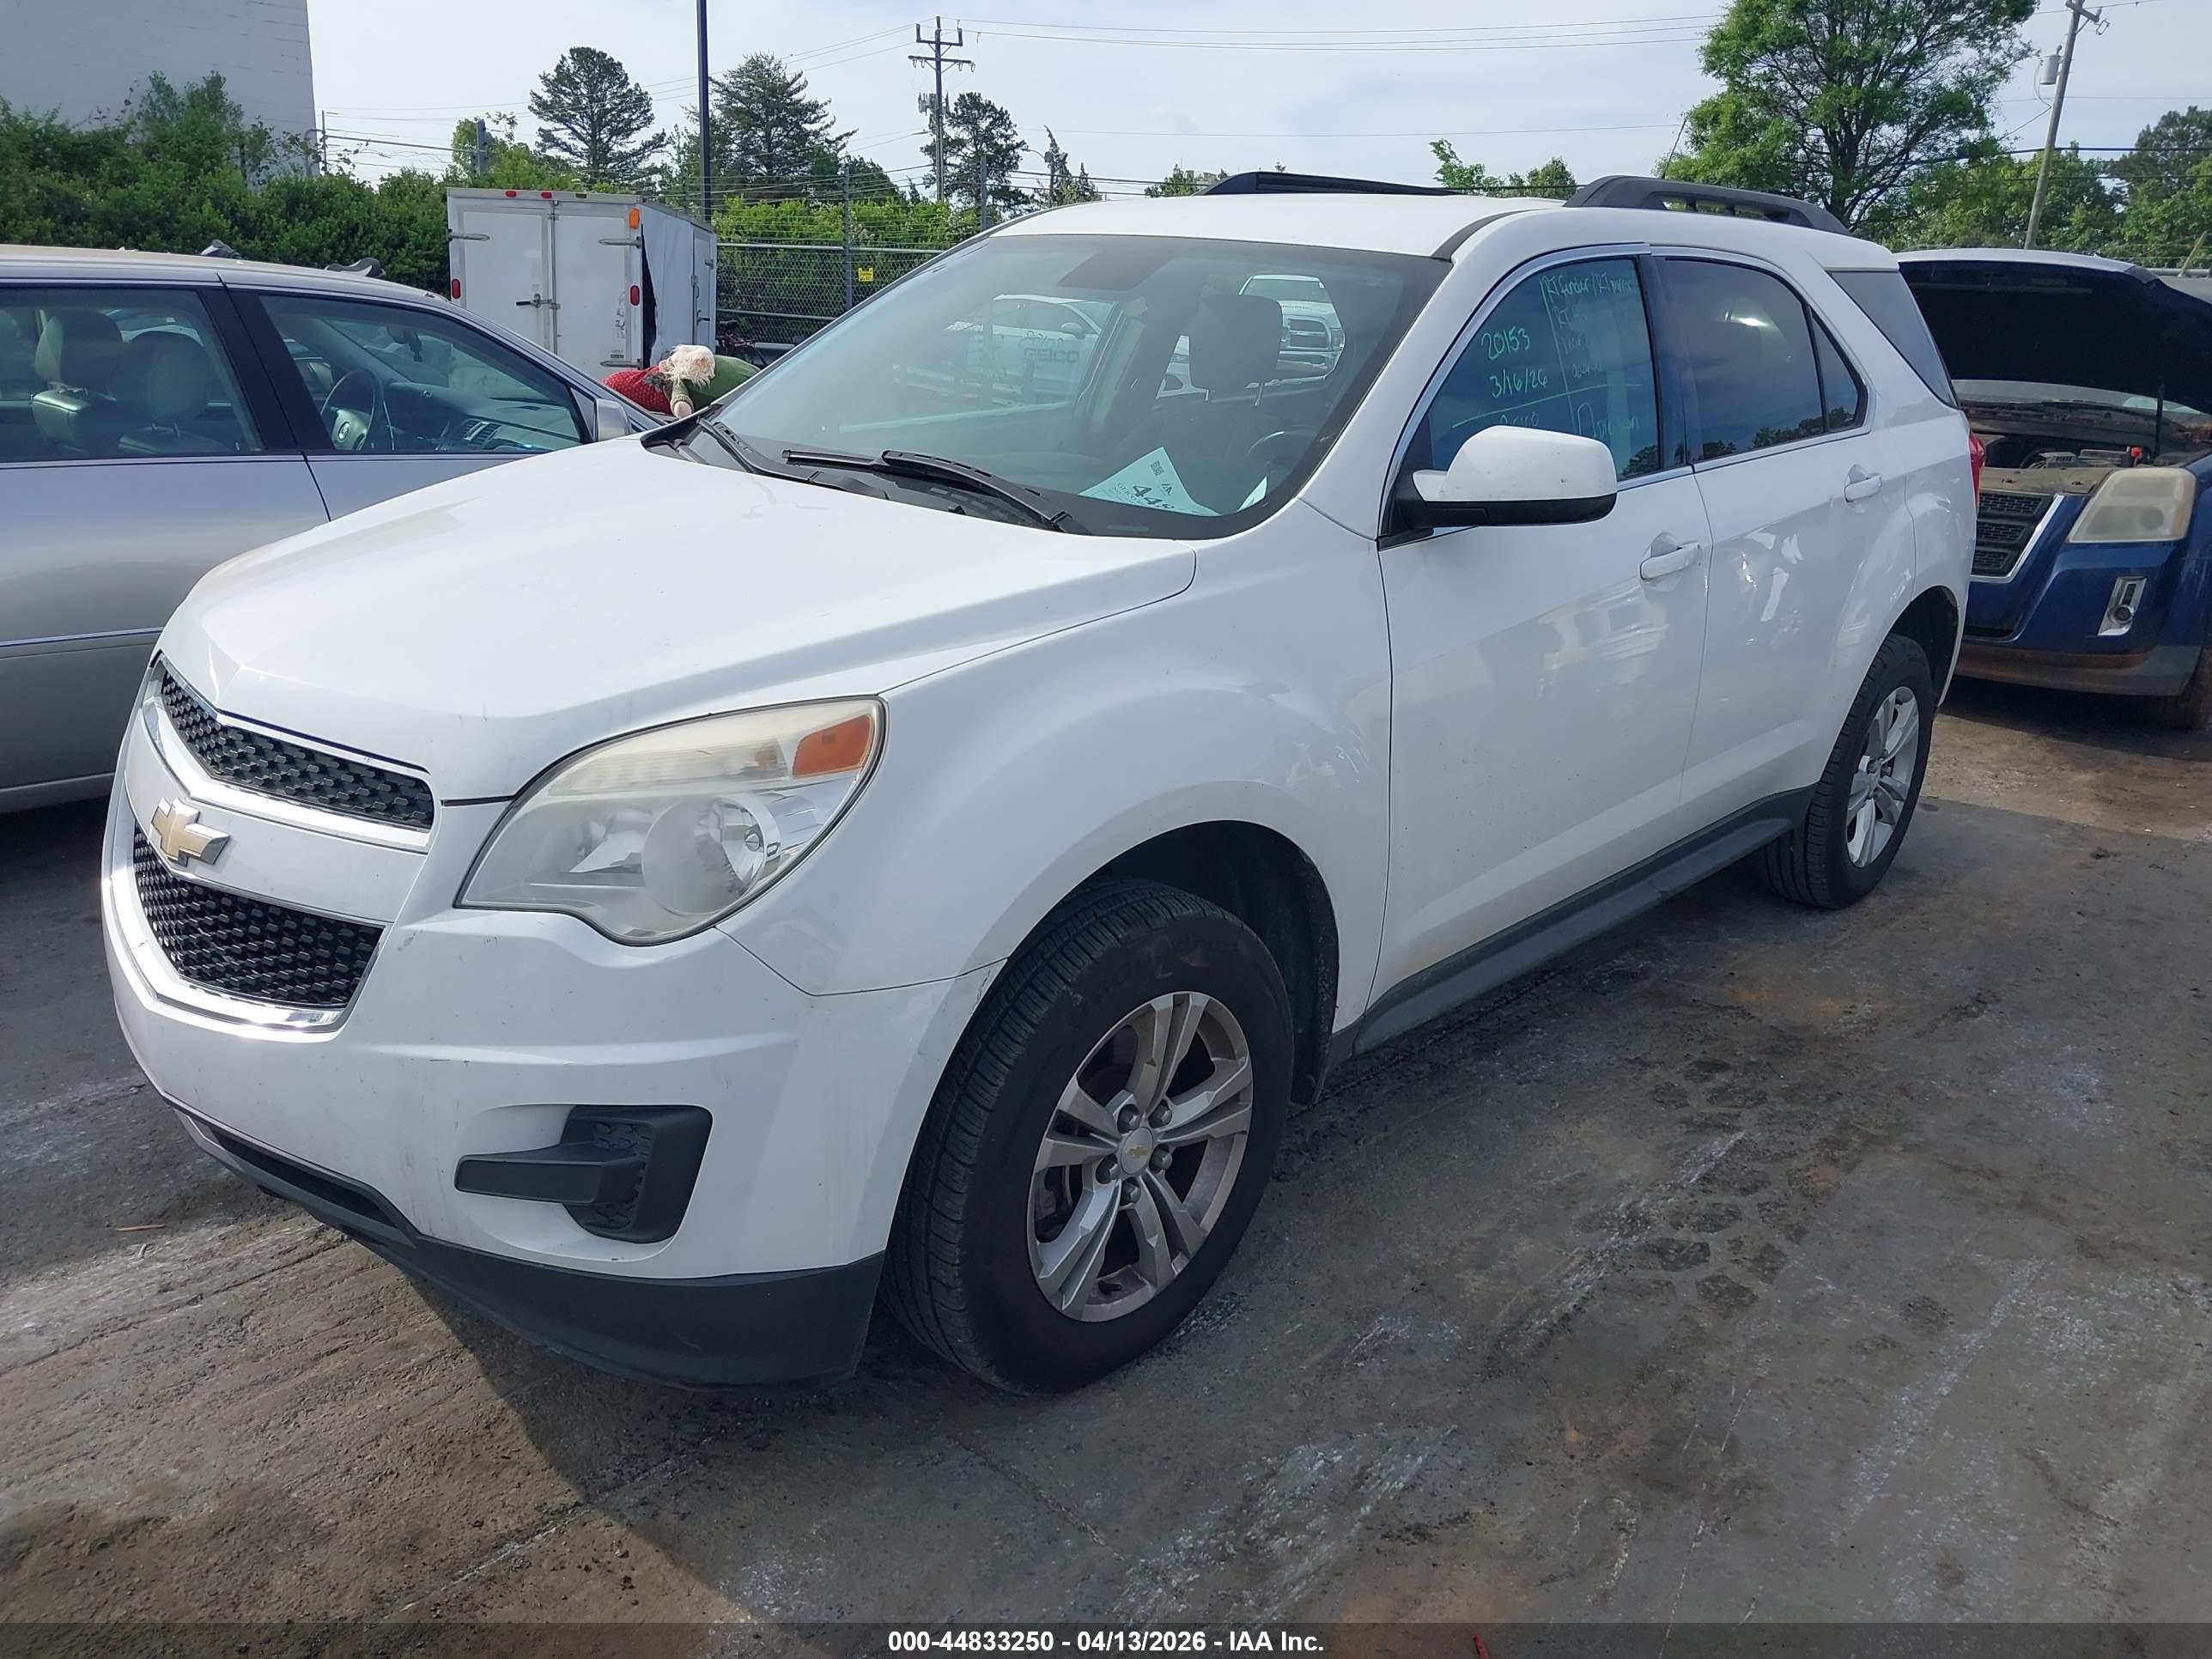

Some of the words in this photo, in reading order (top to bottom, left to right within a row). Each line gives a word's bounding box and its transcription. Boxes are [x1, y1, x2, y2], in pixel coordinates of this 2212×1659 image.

[1023, 348, 1079, 364] GEICO
[1480, 325, 1530, 361] 20153
[1489, 367, 1548, 398] 3/16/26
